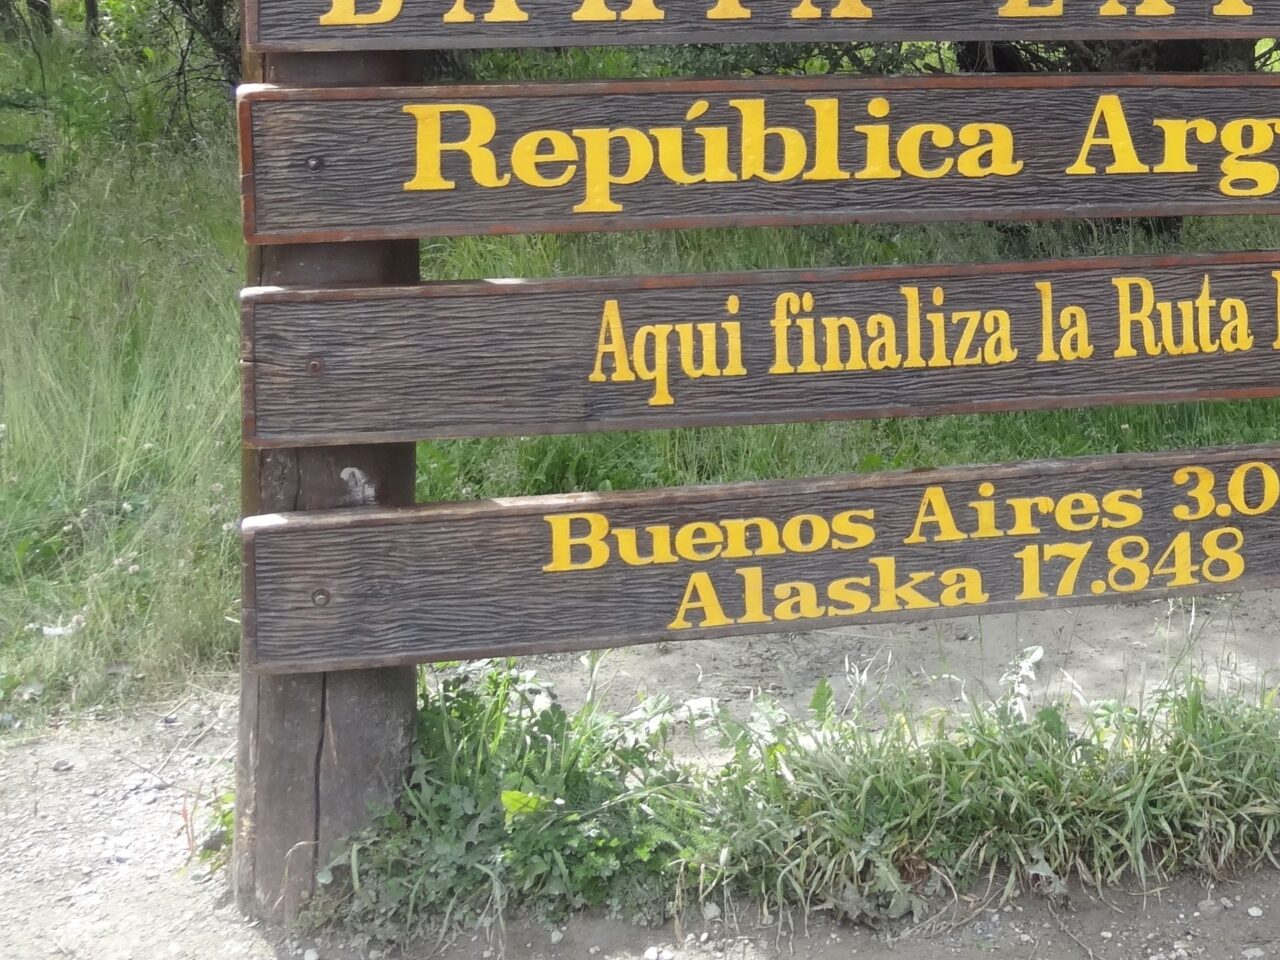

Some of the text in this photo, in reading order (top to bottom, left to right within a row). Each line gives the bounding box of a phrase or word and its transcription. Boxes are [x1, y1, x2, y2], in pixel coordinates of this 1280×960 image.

[401, 96, 1024, 213] República
[588, 294, 747, 406] Aqui
[768, 285, 1018, 374] finaliza
[1034, 281, 1095, 362] la
[1111, 275, 1255, 359] Ruta
[544, 508, 876, 573] Buenos
[903, 481, 1144, 545] Aires
[667, 556, 989, 630] Alaska
[1016, 526, 1245, 600] 17.848
